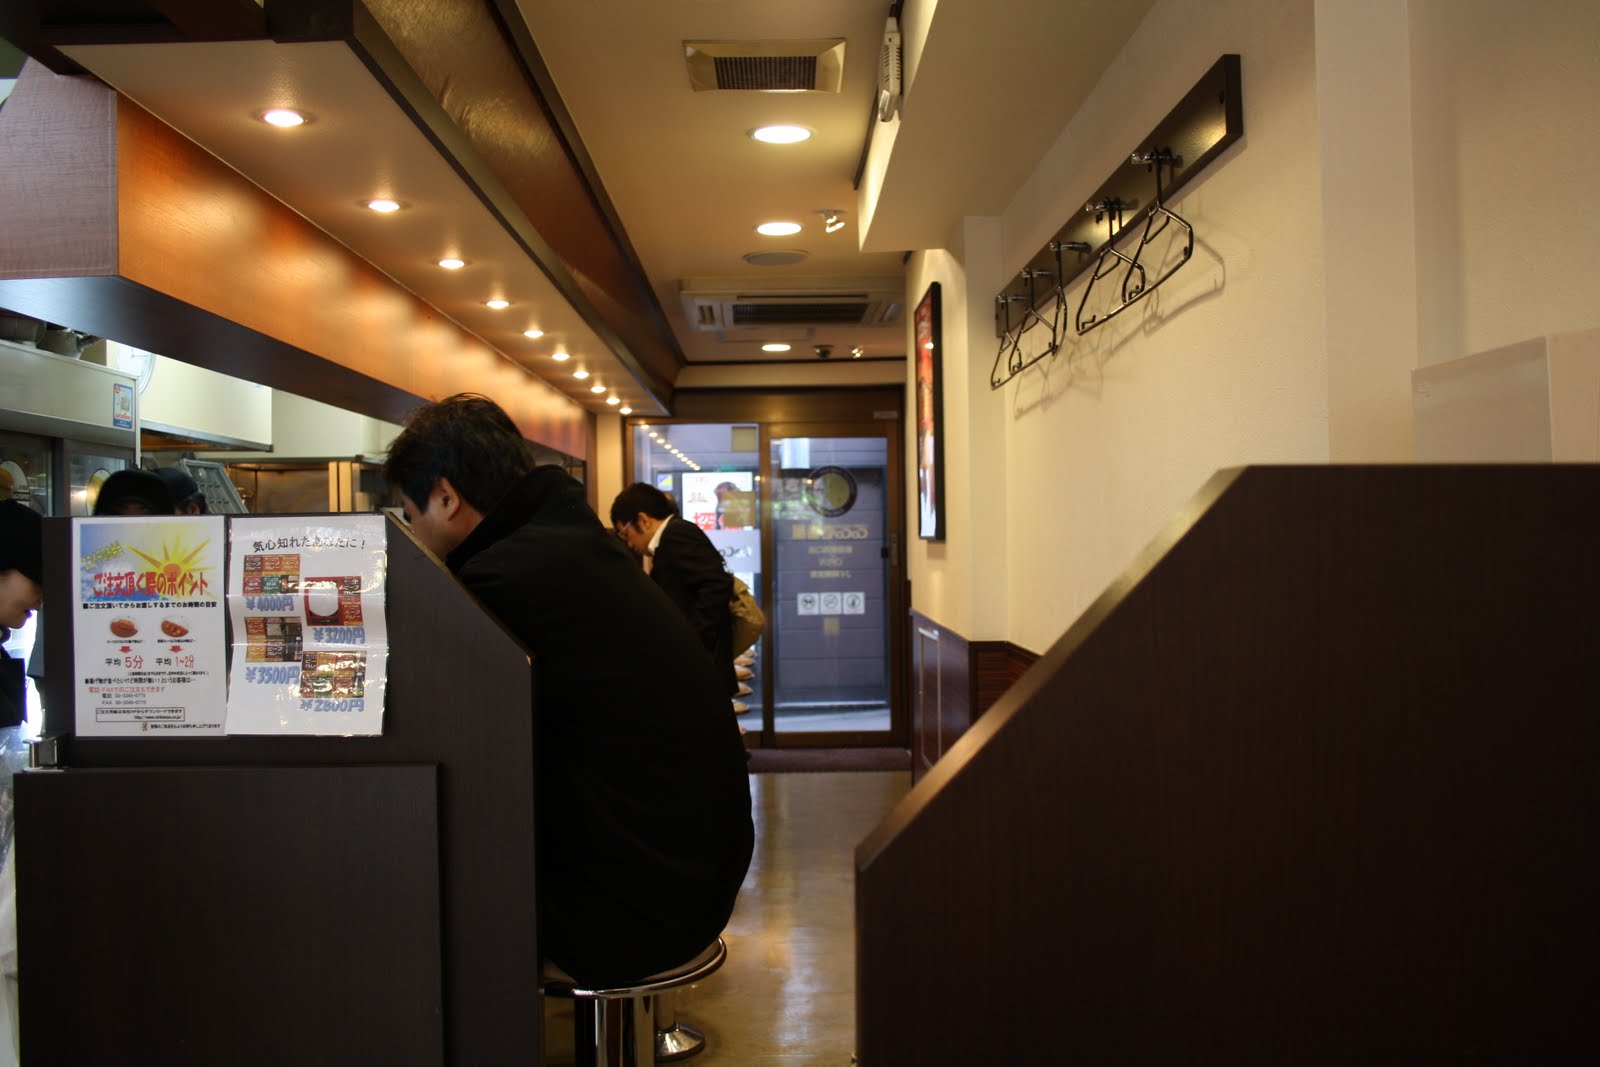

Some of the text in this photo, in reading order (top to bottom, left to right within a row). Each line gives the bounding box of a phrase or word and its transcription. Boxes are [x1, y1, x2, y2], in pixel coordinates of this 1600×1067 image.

[105, 655, 144, 669] 平均 5分
[156, 658, 172, 666] 平均
